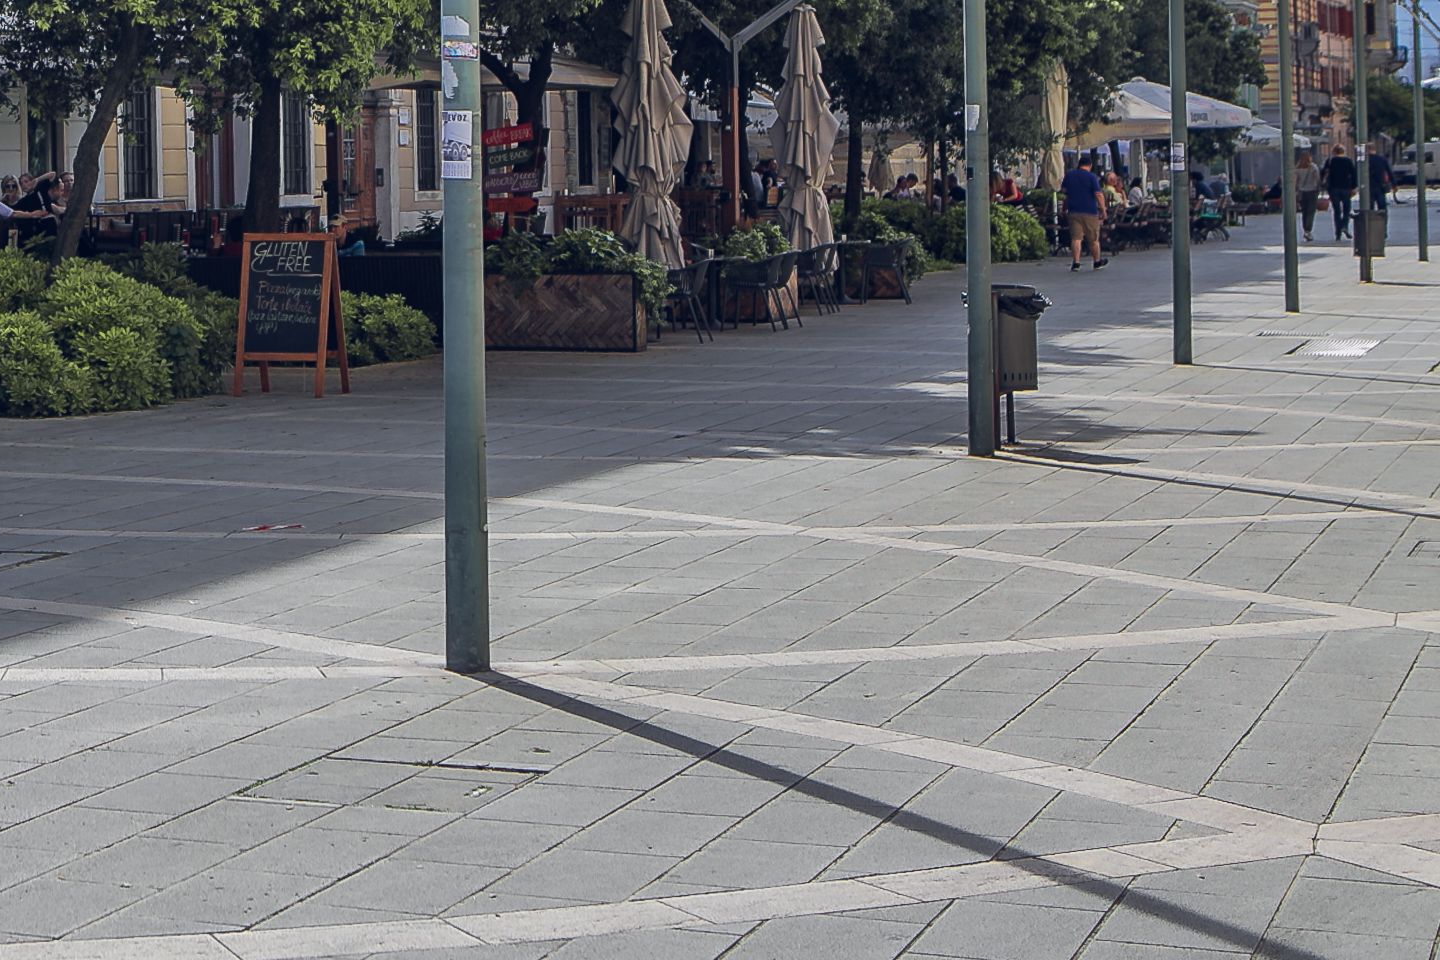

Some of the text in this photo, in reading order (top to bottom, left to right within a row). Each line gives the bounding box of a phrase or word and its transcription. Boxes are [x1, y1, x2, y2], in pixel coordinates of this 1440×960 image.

[447, 114, 467, 122] EVOZ
[254, 241, 309, 258] GLUTEN
[276, 255, 312, 273] FREE
